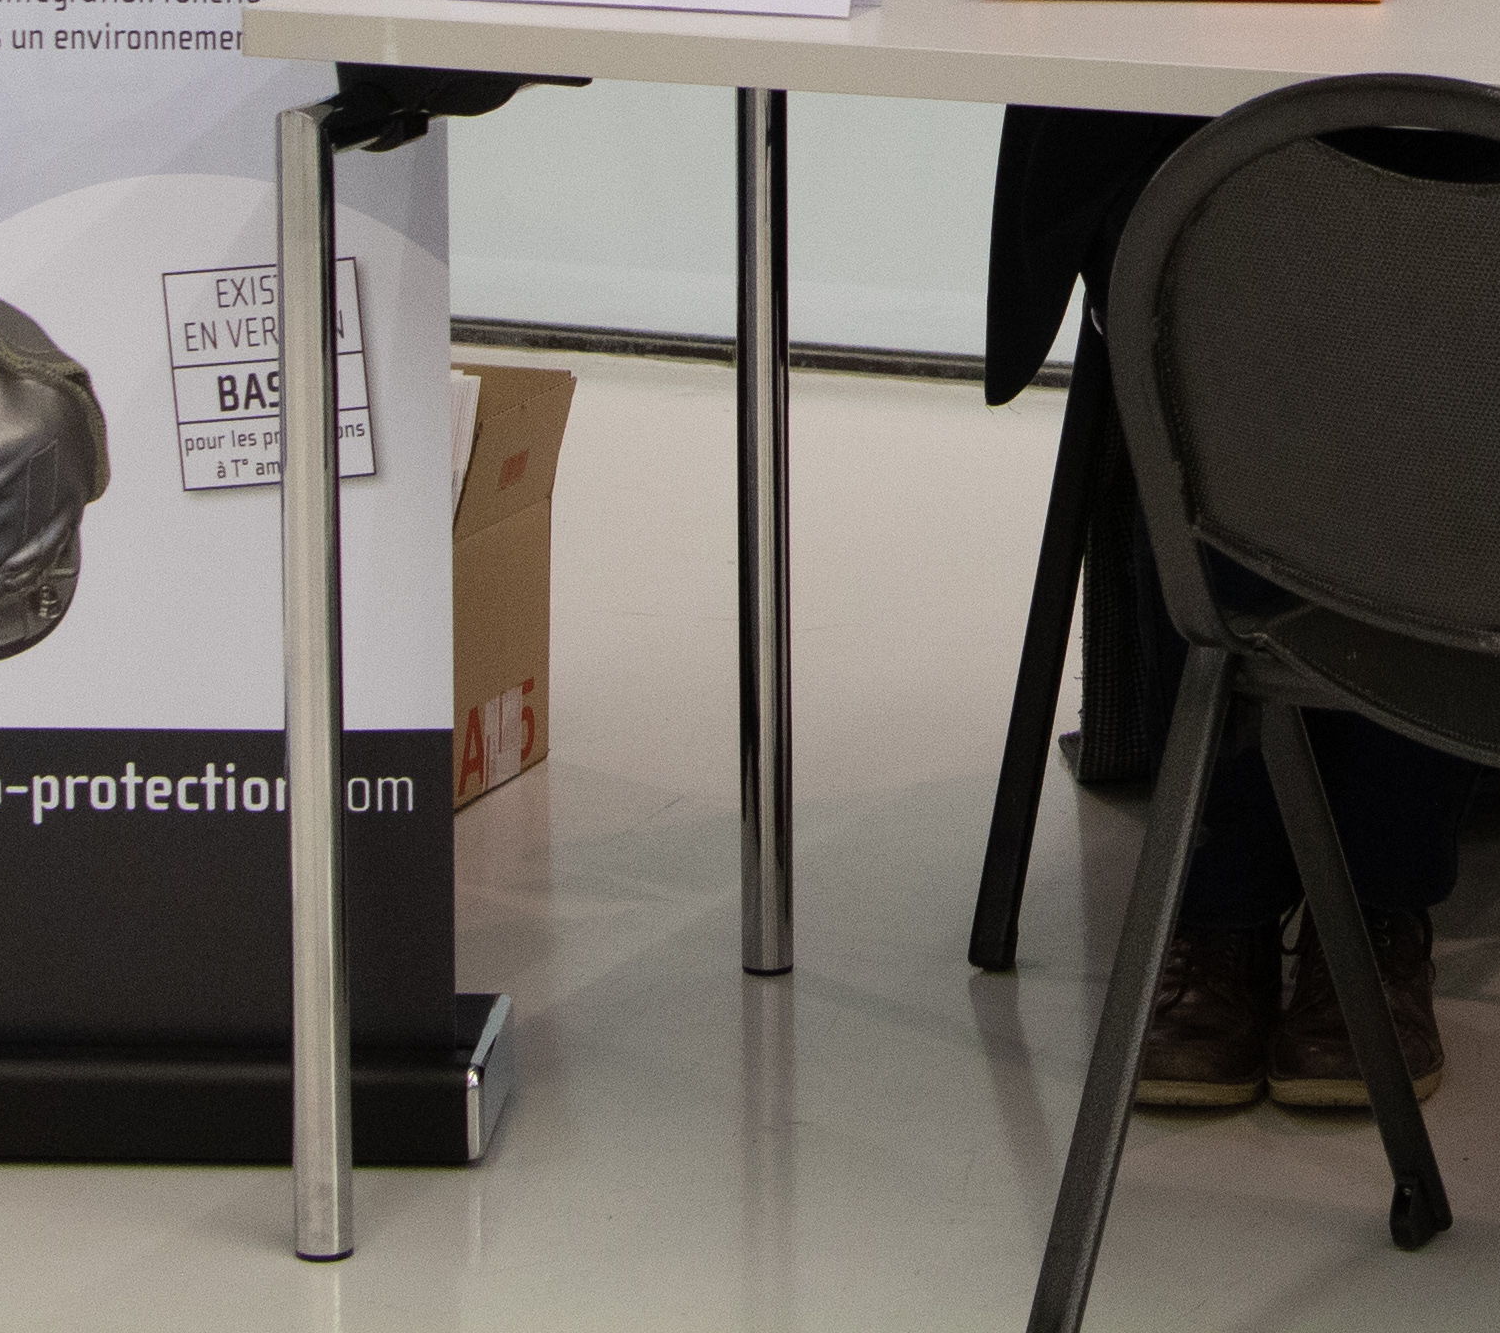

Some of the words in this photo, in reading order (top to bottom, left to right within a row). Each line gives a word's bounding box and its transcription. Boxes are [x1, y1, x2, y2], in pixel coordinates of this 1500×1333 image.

[11, 28, 43, 50] un
[54, 24, 243, 50] environneme
[216, 274, 278, 309] EXIS
[184, 320, 219, 352] EN
[184, 432, 226, 457] pour
[231, 429, 257, 449] les
[216, 461, 227, 479] à
